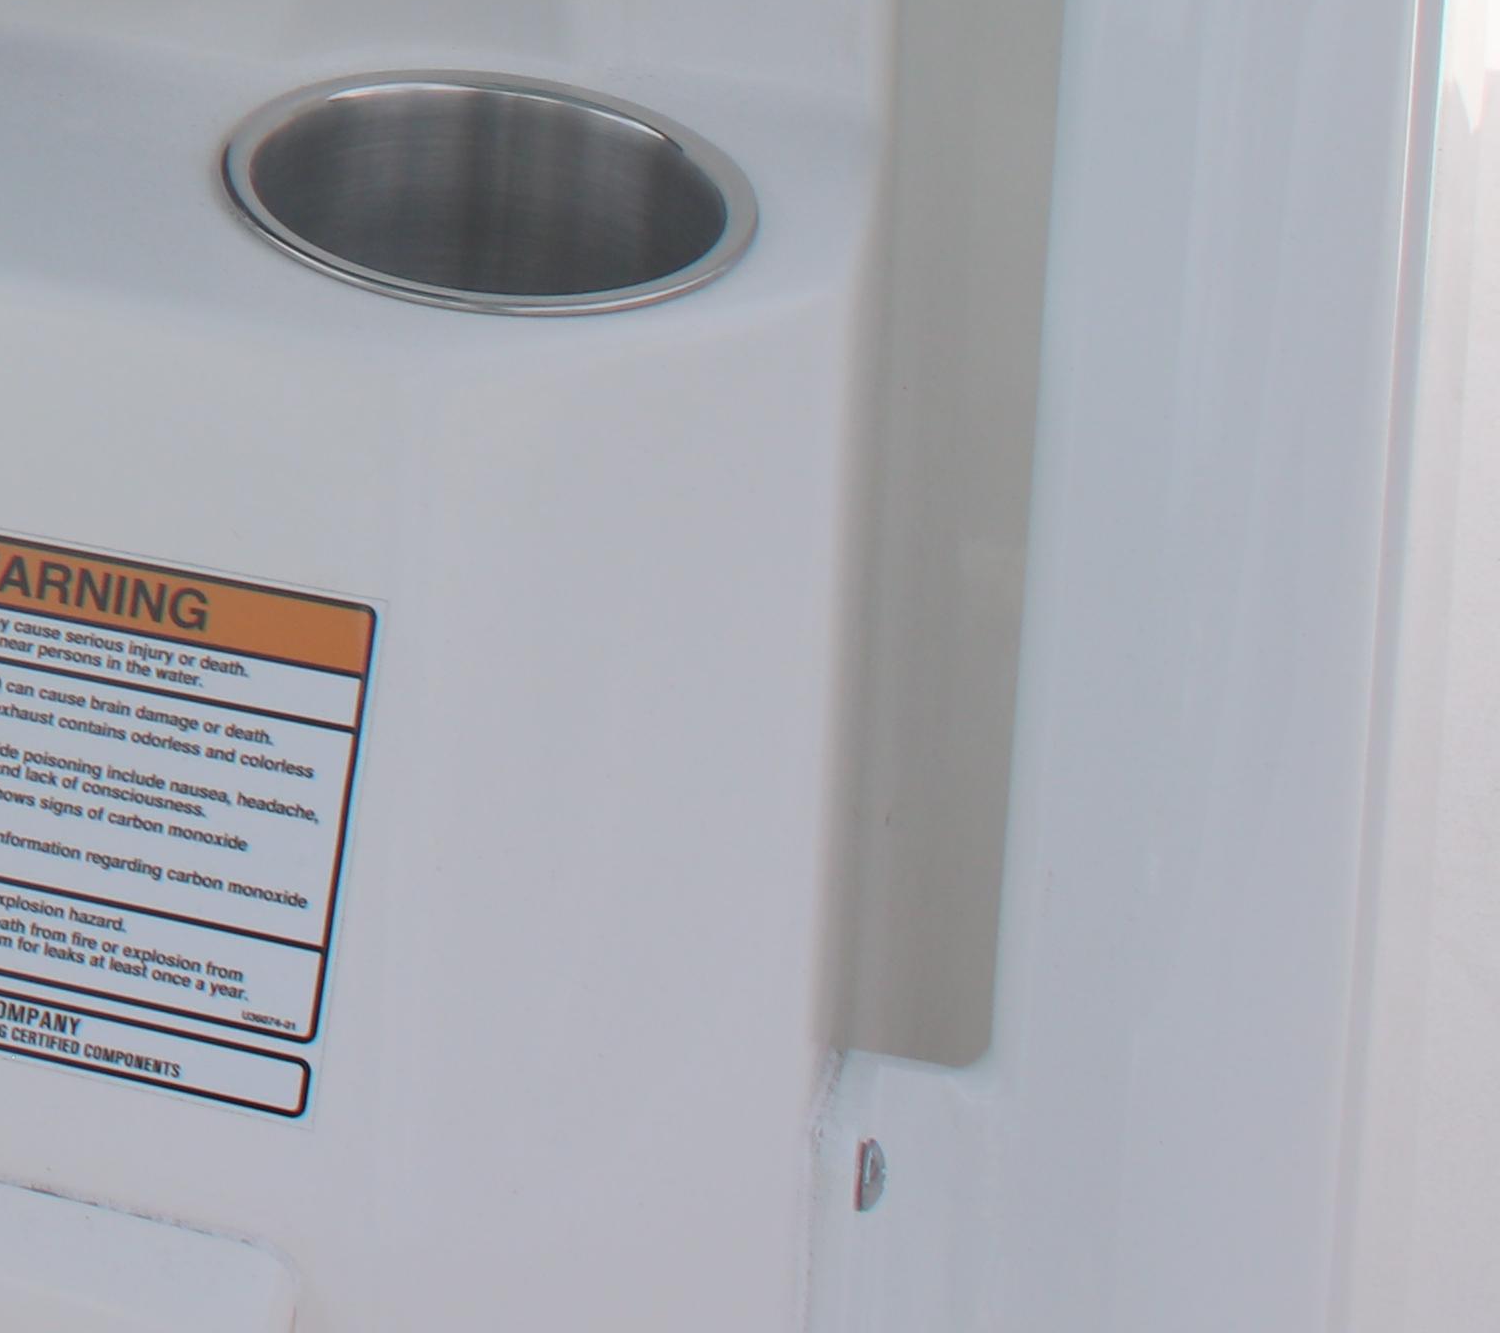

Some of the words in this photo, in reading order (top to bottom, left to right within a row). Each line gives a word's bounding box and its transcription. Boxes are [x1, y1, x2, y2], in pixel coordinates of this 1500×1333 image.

[13, 620, 61, 640] cause
[64, 631, 124, 653] serious
[127, 640, 174, 665] injury
[177, 653, 196, 666] or
[199, 655, 248, 677] death.
[36, 644, 102, 667] persons
[105, 654, 122, 671] in
[125, 658, 152, 677] the
[155, 663, 202, 687] water.
[5, 681, 35, 697] can
[38, 688, 86, 708] cause
[89, 694, 131, 716] brain
[134, 705, 199, 731] damage
[202, 721, 221, 734] or
[223, 723, 273, 746] death.
[10, 1026, 80, 1055] CERTIFIED
[83, 1043, 181, 1078] COMPONENTS
